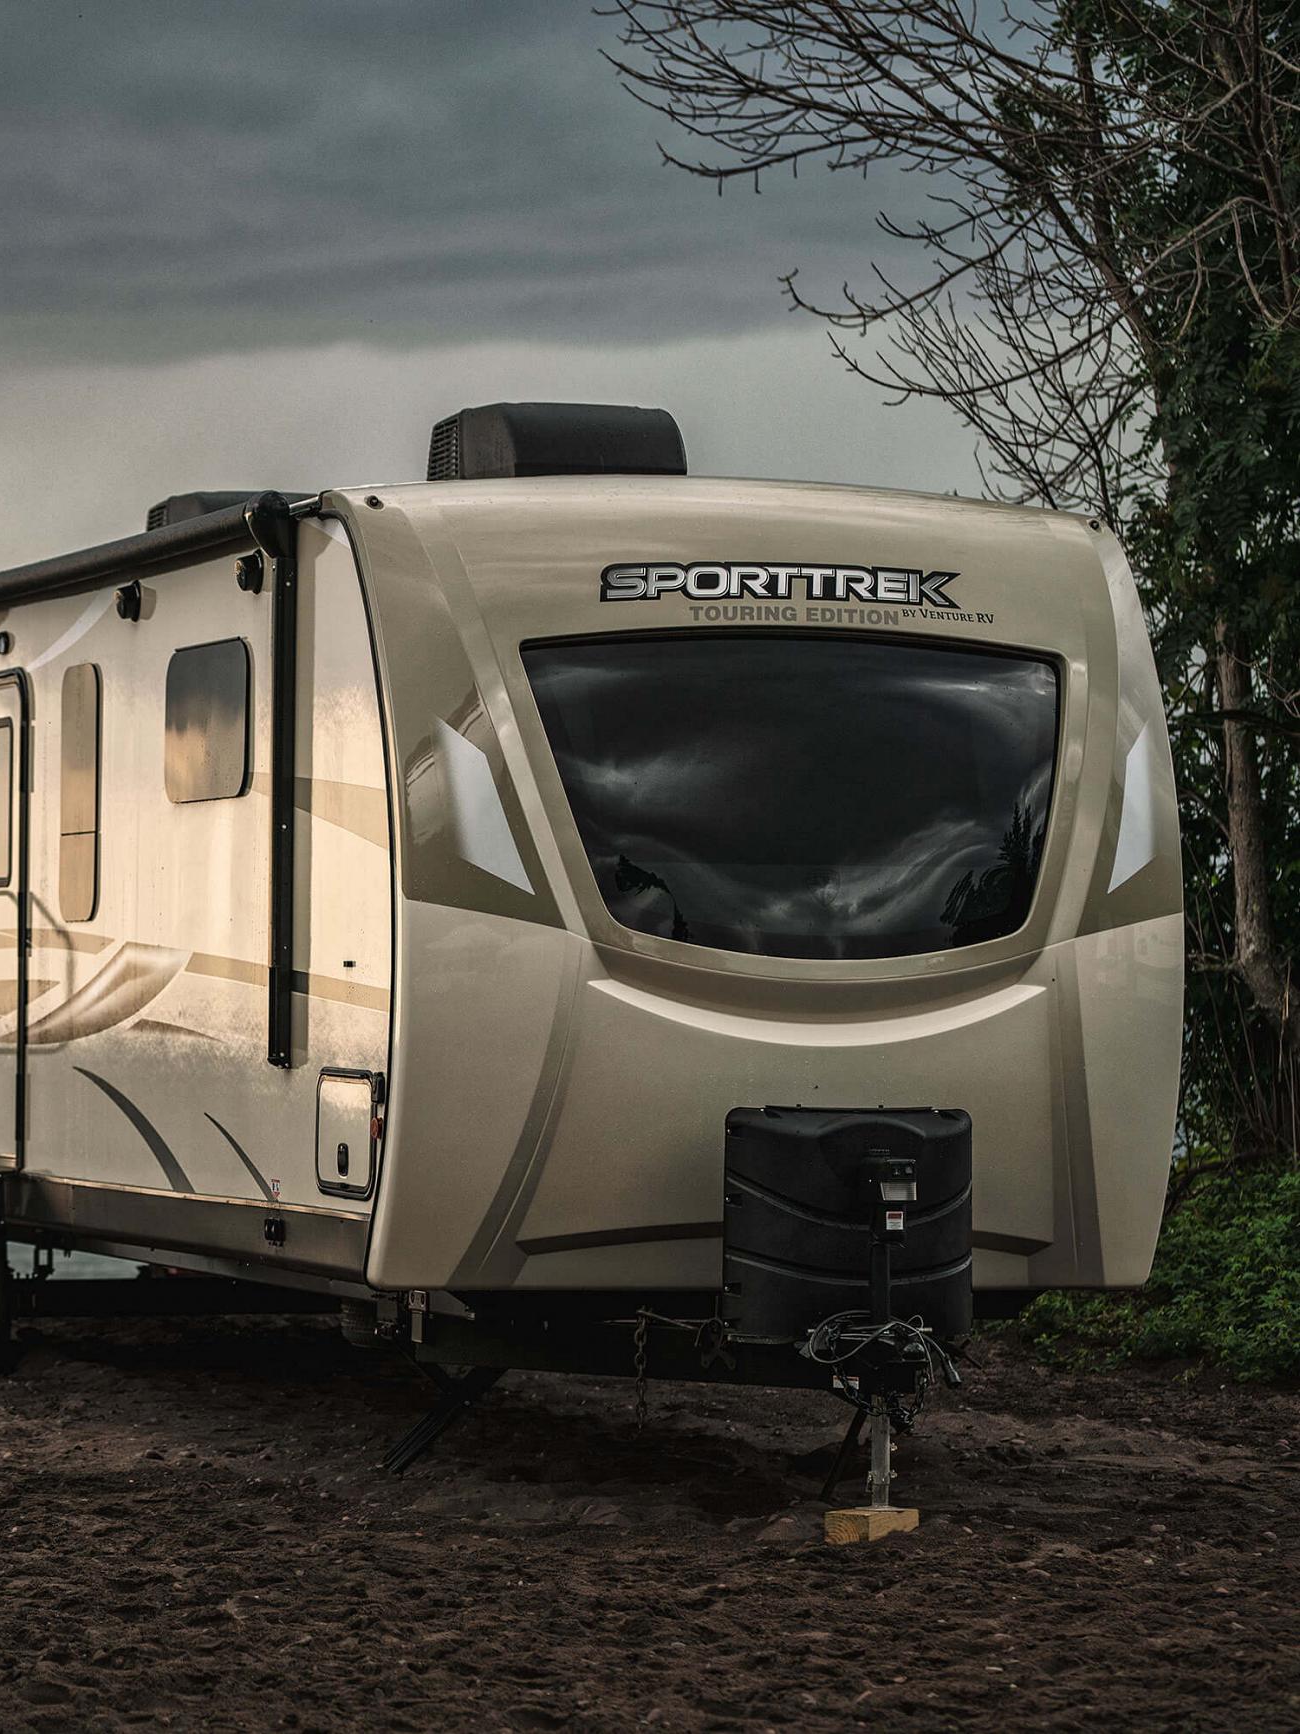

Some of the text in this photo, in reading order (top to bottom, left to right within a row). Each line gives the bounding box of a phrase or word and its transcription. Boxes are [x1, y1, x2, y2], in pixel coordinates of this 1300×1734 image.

[601, 562, 961, 609] SPORTTREK
[689, 605, 899, 625] TOURING EDITION
[902, 608, 994, 624] BY VENTURE RV
